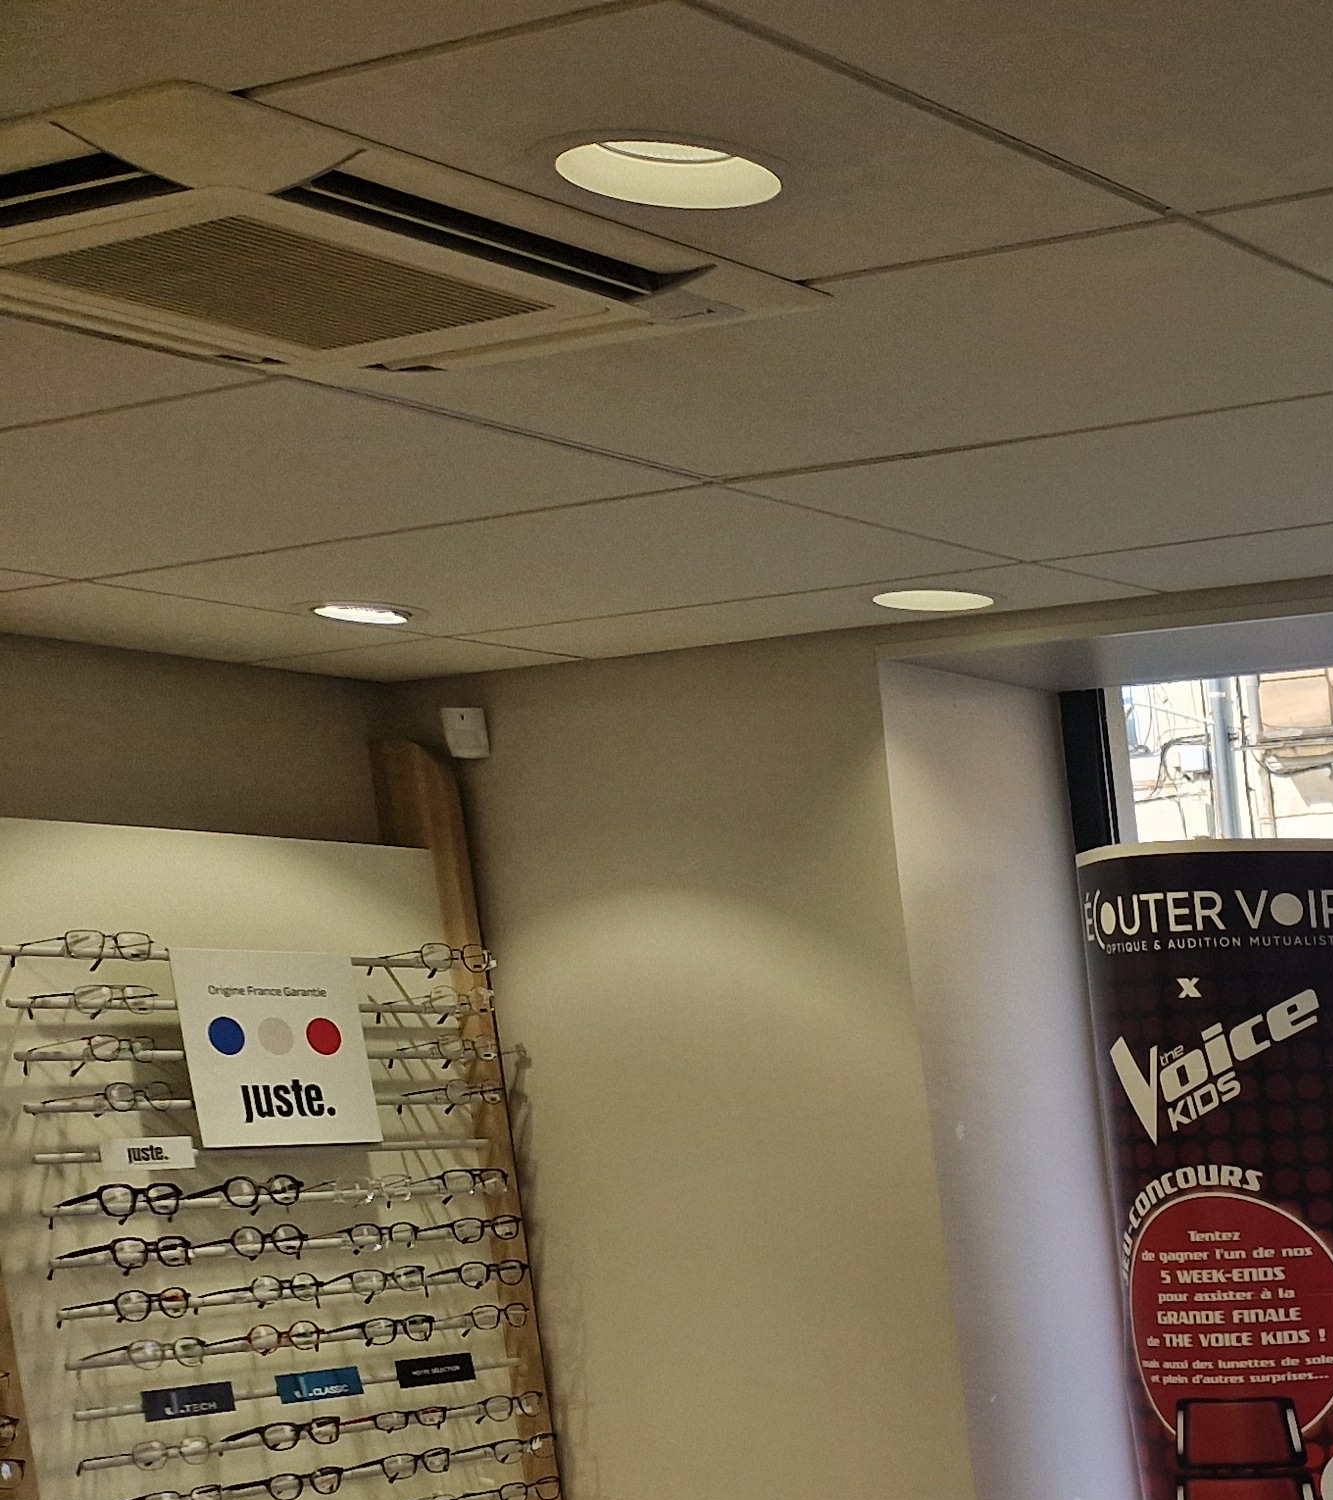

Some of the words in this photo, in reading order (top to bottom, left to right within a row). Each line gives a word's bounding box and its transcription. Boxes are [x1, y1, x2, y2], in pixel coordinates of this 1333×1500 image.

[1105, 939, 1149, 955] OPTIQUE
[1153, 939, 1162, 951] &
[1168, 937, 1242, 951] AUDITION
[207, 985, 246, 998] Origine
[247, 985, 282, 997] France
[283, 986, 328, 998] Garantie
[1159, 1043, 1185, 1066] the
[1109, 987, 1321, 1147] Voice
[240, 1078, 337, 1124] juste.
[1166, 1070, 1242, 1132] KIDS
[127, 1144, 169, 1164] juste.
[1187, 1229, 1241, 1242] Tentez
[1141, 1250, 1156, 1262] de
[1159, 1250, 1210, 1264] gagner
[1214, 1247, 1247, 1260] l'un
[1252, 1246, 1276, 1259] de
[1281, 1246, 1314, 1258] nos
[1160, 1270, 1171, 1284] 5
[1176, 1266, 1286, 1284] WEEK-ENDS
[1158, 1291, 1189, 1304] pour
[1193, 1289, 1254, 1302] assister
[1260, 1287, 1273, 1300] à
[1277, 1286, 1296, 1299] la
[1156, 1310, 1226, 1325] GRANDE
[1232, 1306, 1302, 1324] FINALE
[1146, 1336, 1161, 1347] de
[1162, 1333, 1194, 1348] THE
[1199, 1331, 1254, 1347] VOICE
[1260, 1329, 1311, 1346] KIDS
[1318, 1327, 1327, 1343] !
[1163, 1359, 1189, 1370] aussi
[1192, 1359, 1214, 1370] des
[1217, 1357, 1276, 1370] lunettes
[1280, 1356, 1301, 1367] de
[1150, 1374, 1161, 1384] et
[1163, 1373, 1189, 1386] plein
[1191, 1373, 1245, 1384] d'autres
